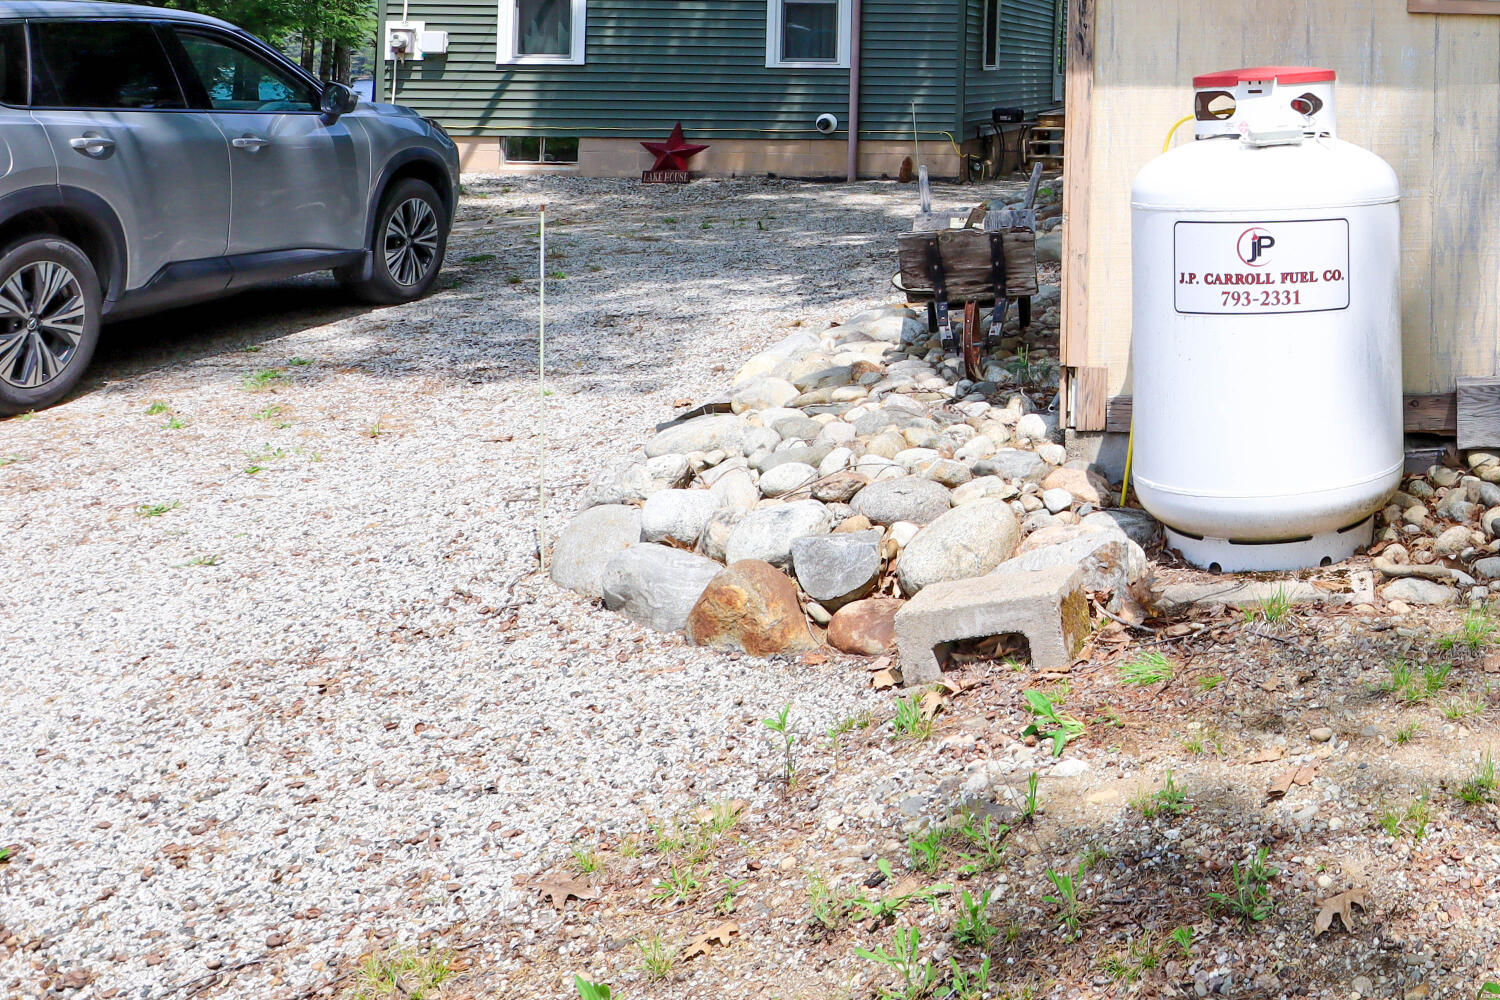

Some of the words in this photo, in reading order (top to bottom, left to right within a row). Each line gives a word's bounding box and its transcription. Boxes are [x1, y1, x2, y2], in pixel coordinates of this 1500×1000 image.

[643, 171, 662, 182] LAKE
[664, 171, 689, 182] HOUSE
[1179, 272, 1199, 285] J.P.
[1203, 271, 1275, 285] CARROLL
[1280, 271, 1318, 284] FUEL
[1322, 269, 1345, 282] CO.
[1221, 289, 1301, 307] 793-2331
